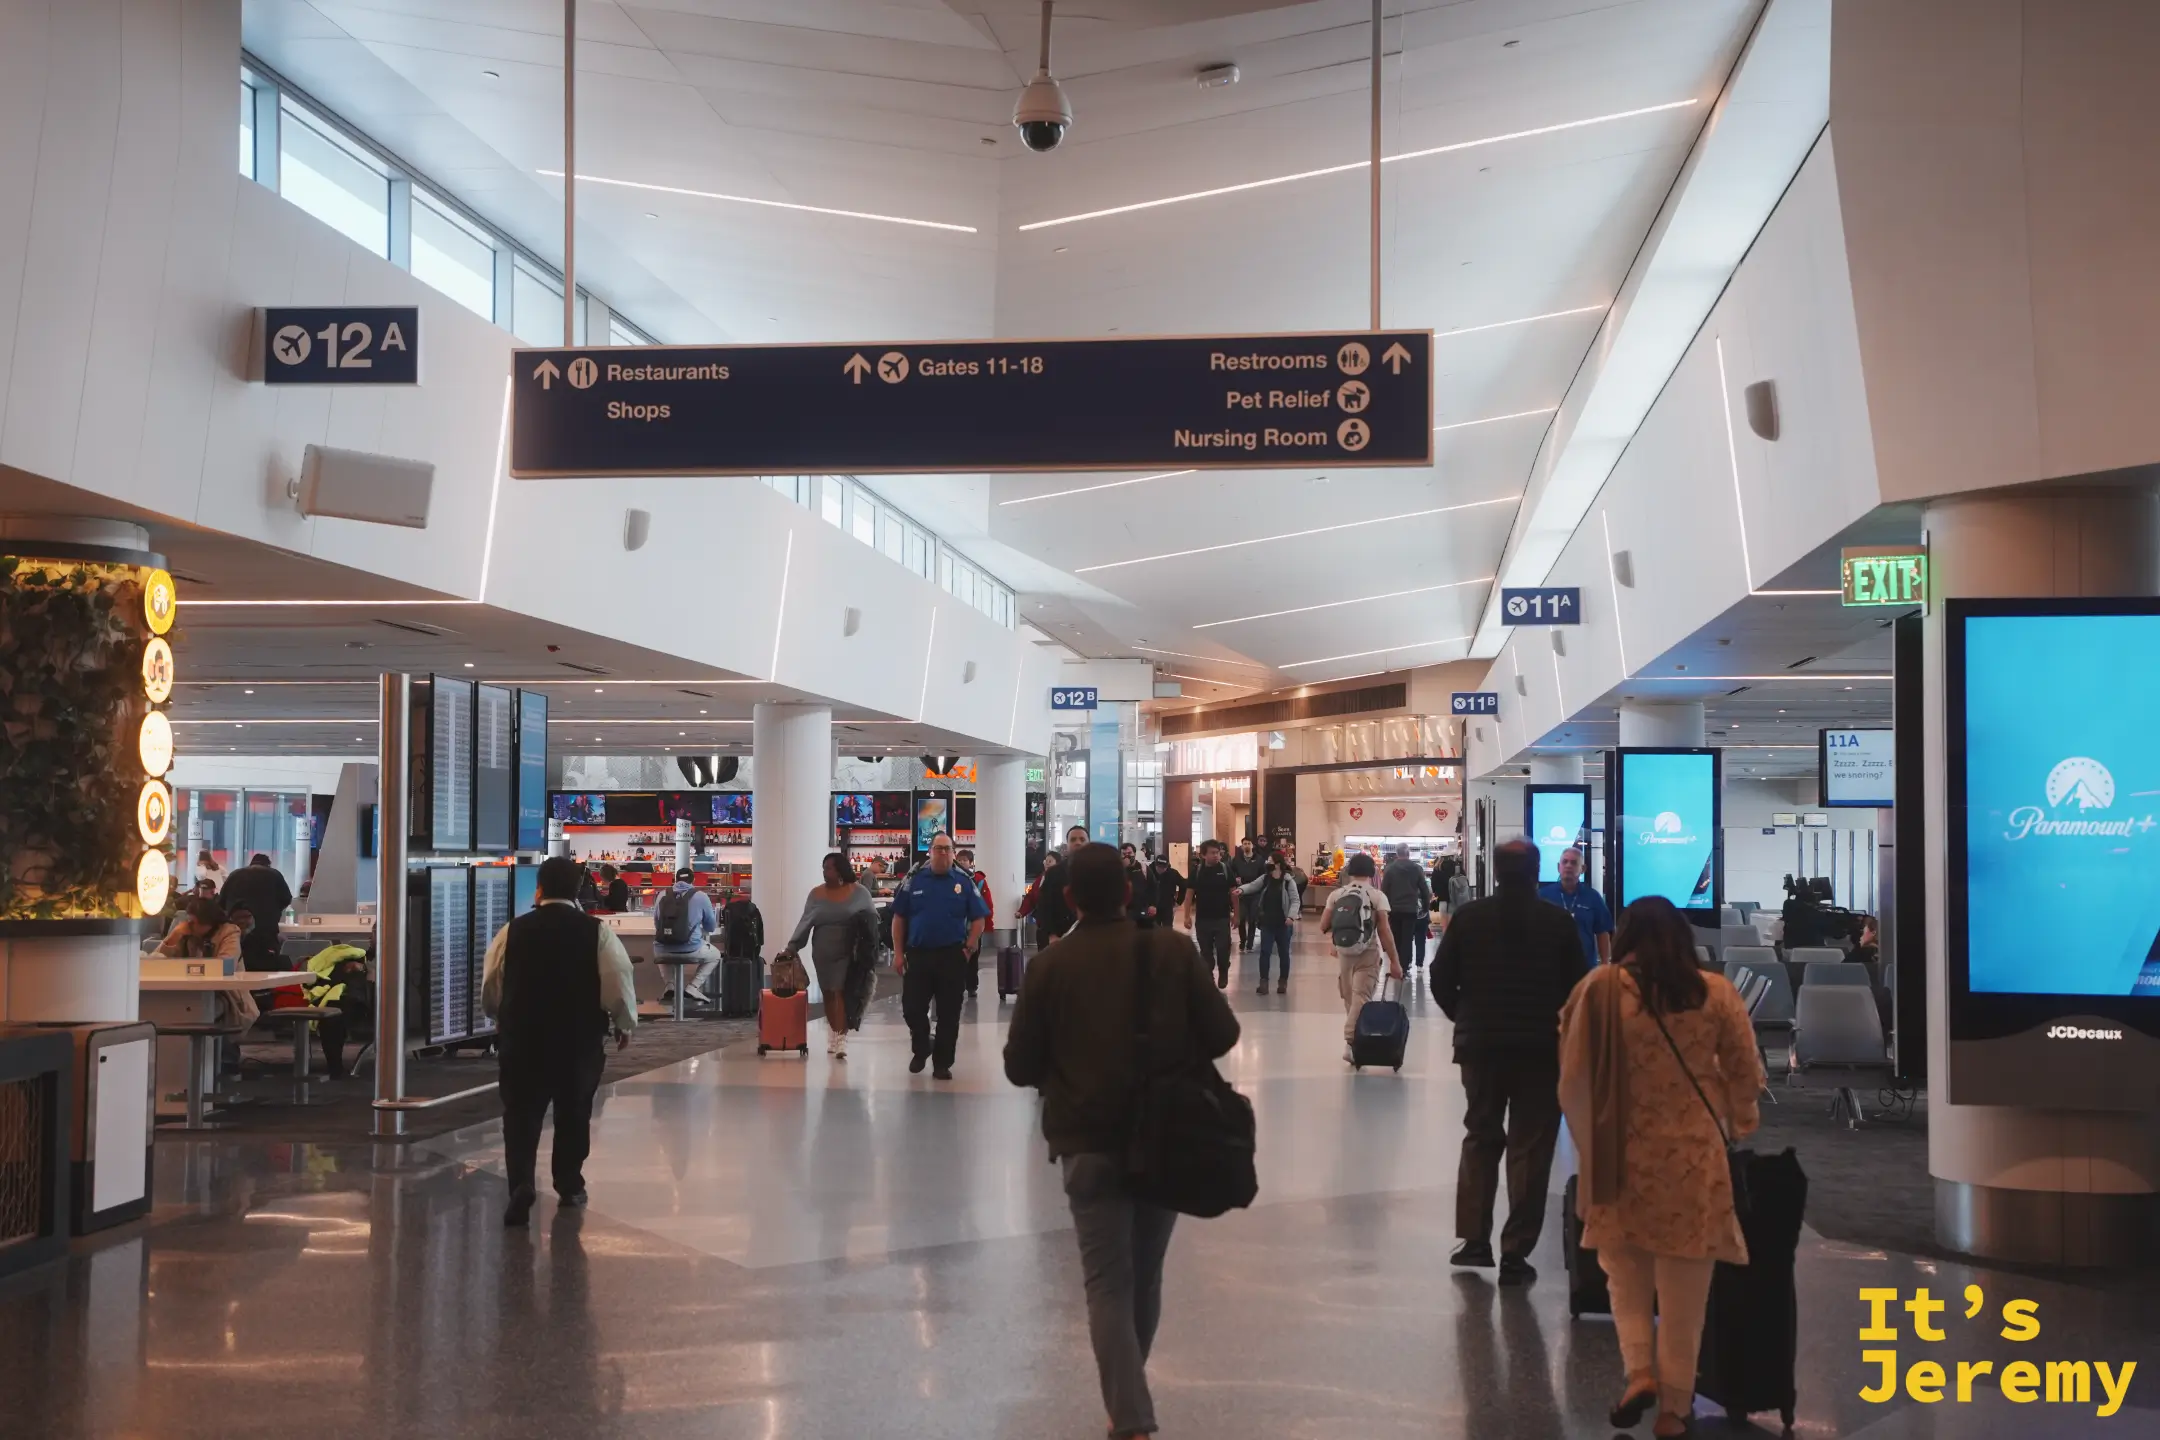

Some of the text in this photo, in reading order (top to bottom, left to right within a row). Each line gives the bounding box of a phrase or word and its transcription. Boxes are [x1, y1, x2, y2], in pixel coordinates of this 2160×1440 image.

[919, 356, 1044, 376] Gates 11-18
[1210, 353, 1328, 371] Restrooms
[607, 363, 730, 381] Restaurants
[1226, 389, 1331, 409] Pet Relief
[607, 401, 671, 422] Shops
[1174, 428, 1328, 450] Nursing Room
[1853, 560, 1916, 601] EXIT
[1829, 734, 1860, 748] 11A
[1848, 771, 1884, 780] snoring?
[2046, 1025, 2123, 1040] JCDecaux
